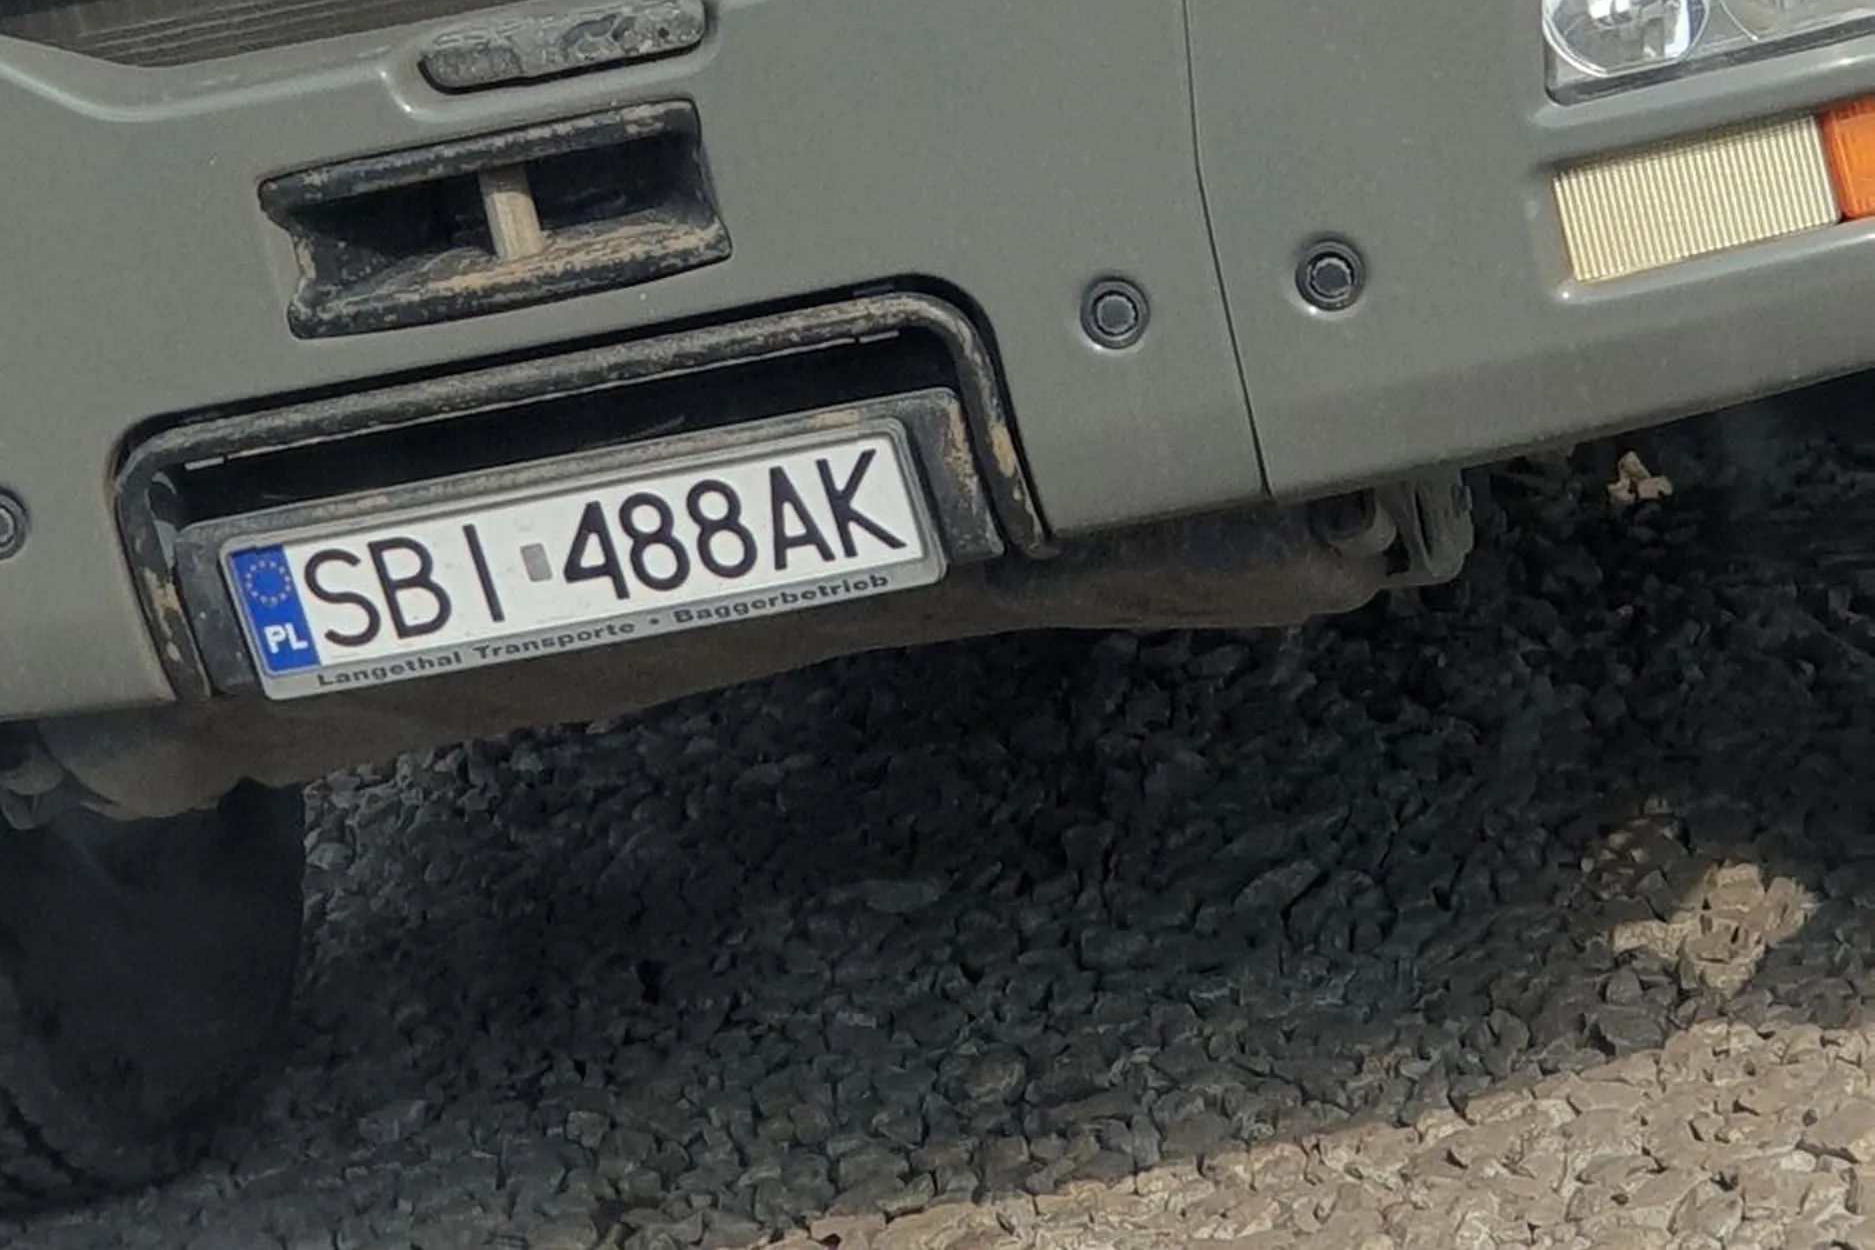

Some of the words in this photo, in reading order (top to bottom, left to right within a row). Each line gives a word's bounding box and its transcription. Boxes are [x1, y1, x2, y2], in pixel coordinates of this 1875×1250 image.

[303, 522, 506, 648] SBI
[562, 448, 907, 600] 488AK
[263, 622, 309, 655] PL
[316, 650, 463, 688] Langethal
[472, 617, 636, 662] Transporte
[673, 574, 890, 626] Baggerbetrieb
